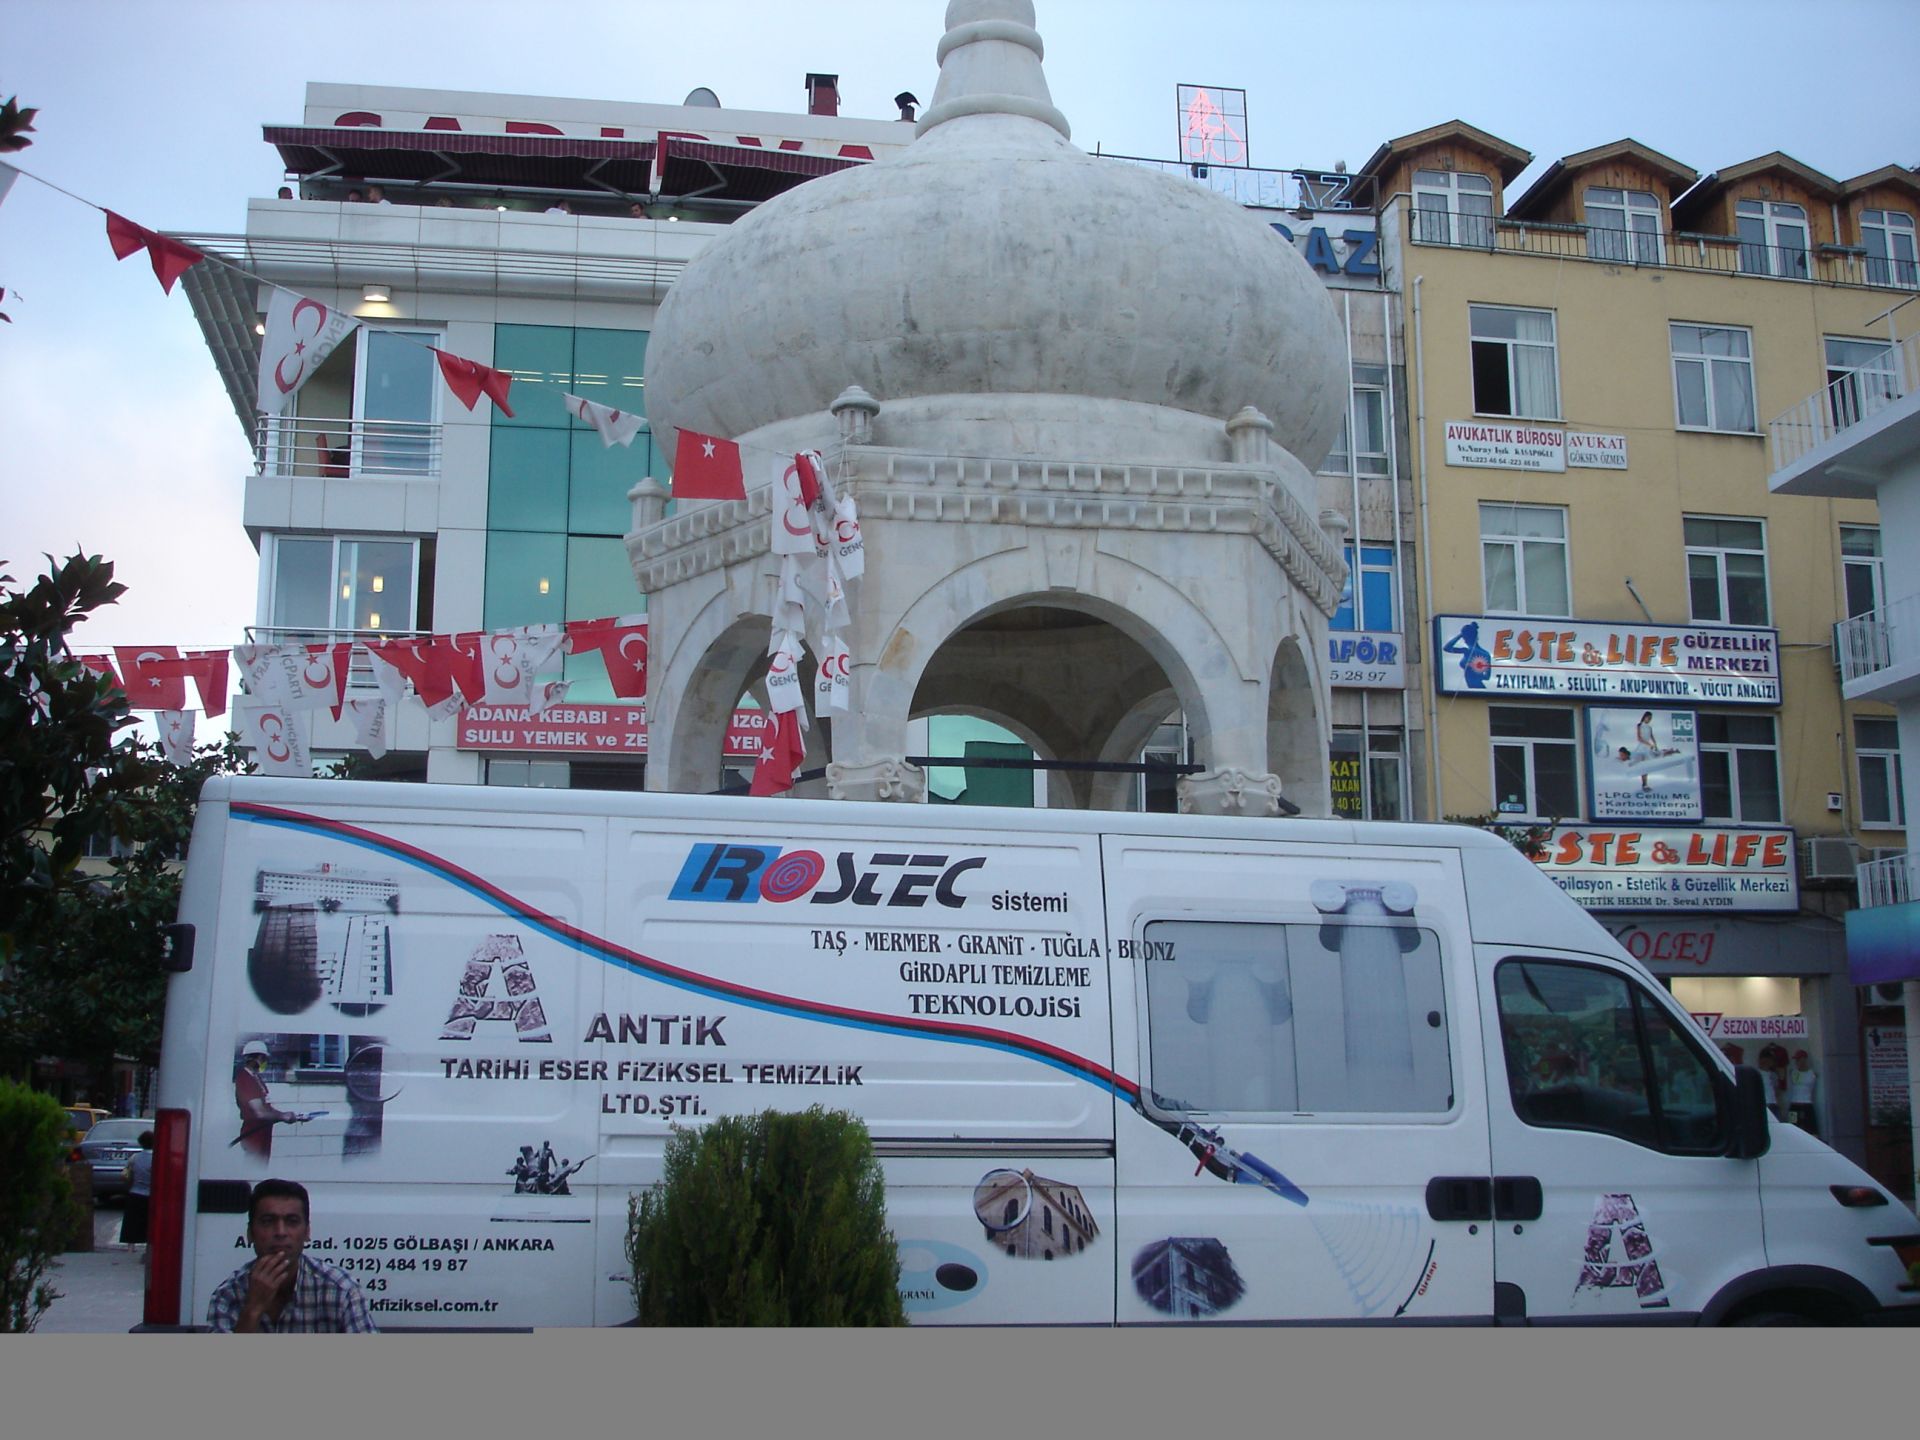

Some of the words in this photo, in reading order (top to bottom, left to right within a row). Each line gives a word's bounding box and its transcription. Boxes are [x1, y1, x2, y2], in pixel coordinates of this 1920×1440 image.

[1448, 425, 1512, 444] AVUKATLIK
[1516, 428, 1562, 447] BÜROSU
[1568, 436, 1625, 450] AVUKAT
[1492, 629, 1575, 663] ESTE
[1606, 633, 1680, 668] LIFE
[1683, 631, 1772, 652] GÜZELLİK
[1686, 653, 1769, 673] MERKEZİ
[1345, 671, 1363, 681] 28
[1367, 672, 1386, 682] 97
[1496, 674, 1556, 690] ZAYIFLAMA
[1567, 674, 1607, 692] SELÜLİT
[1620, 680, 1690, 695] AKUPUNKTUR
[1700, 679, 1735, 698] VÜCUT
[1737, 682, 1776, 699] ANALİZİ
[466, 707, 531, 723] ADANA
[539, 709, 607, 724] KEBABI
[628, 708, 647, 726] Pİ
[1672, 719, 1693, 730] LPG
[464, 728, 515, 744] SULU
[523, 730, 588, 746] YEMEK
[596, 735, 617, 746] ve
[625, 733, 648, 747] ZE
[1605, 800, 1699, 808] Karboksiterapi
[1606, 808, 1687, 817] Pressoterapi
[1651, 841, 1680, 864] &
[1686, 832, 1789, 868] LIFE
[1626, 877, 1666, 891] Estetik
[1671, 878, 1681, 891] &
[1685, 878, 1736, 892] Güzellik
[1740, 878, 1790, 892] Merkezi
[991, 889, 1069, 914] sistemi
[1572, 895, 1615, 906] STETİK
[1618, 895, 1652, 905] HEKİM
[1655, 897, 1669, 906] Dr.
[1673, 897, 1699, 906] Seval
[1702, 897, 1733, 906] AYDIN
[811, 930, 848, 957] TAŞ
[865, 932, 941, 953] MERMER
[1041, 932, 1100, 958] TUĞLA
[1117, 939, 1176, 962] BRONZ
[1723, 1020, 1757, 1034] SEZON
[1761, 1020, 1805, 1038] BAŞLADI
[539, 1060, 608, 1081] ESER
[343, 1237, 388, 1250] 102/5
[393, 1235, 469, 1253] GÖLBAŞI
[482, 1238, 555, 1251] ANKARA
[339, 1257, 381, 1274] (312)
[386, 1258, 416, 1271] 484
[422, 1259, 442, 1271] 19
[447, 1259, 469, 1272] 87
[368, 1299, 499, 1313] kfiziksel.com.tr
